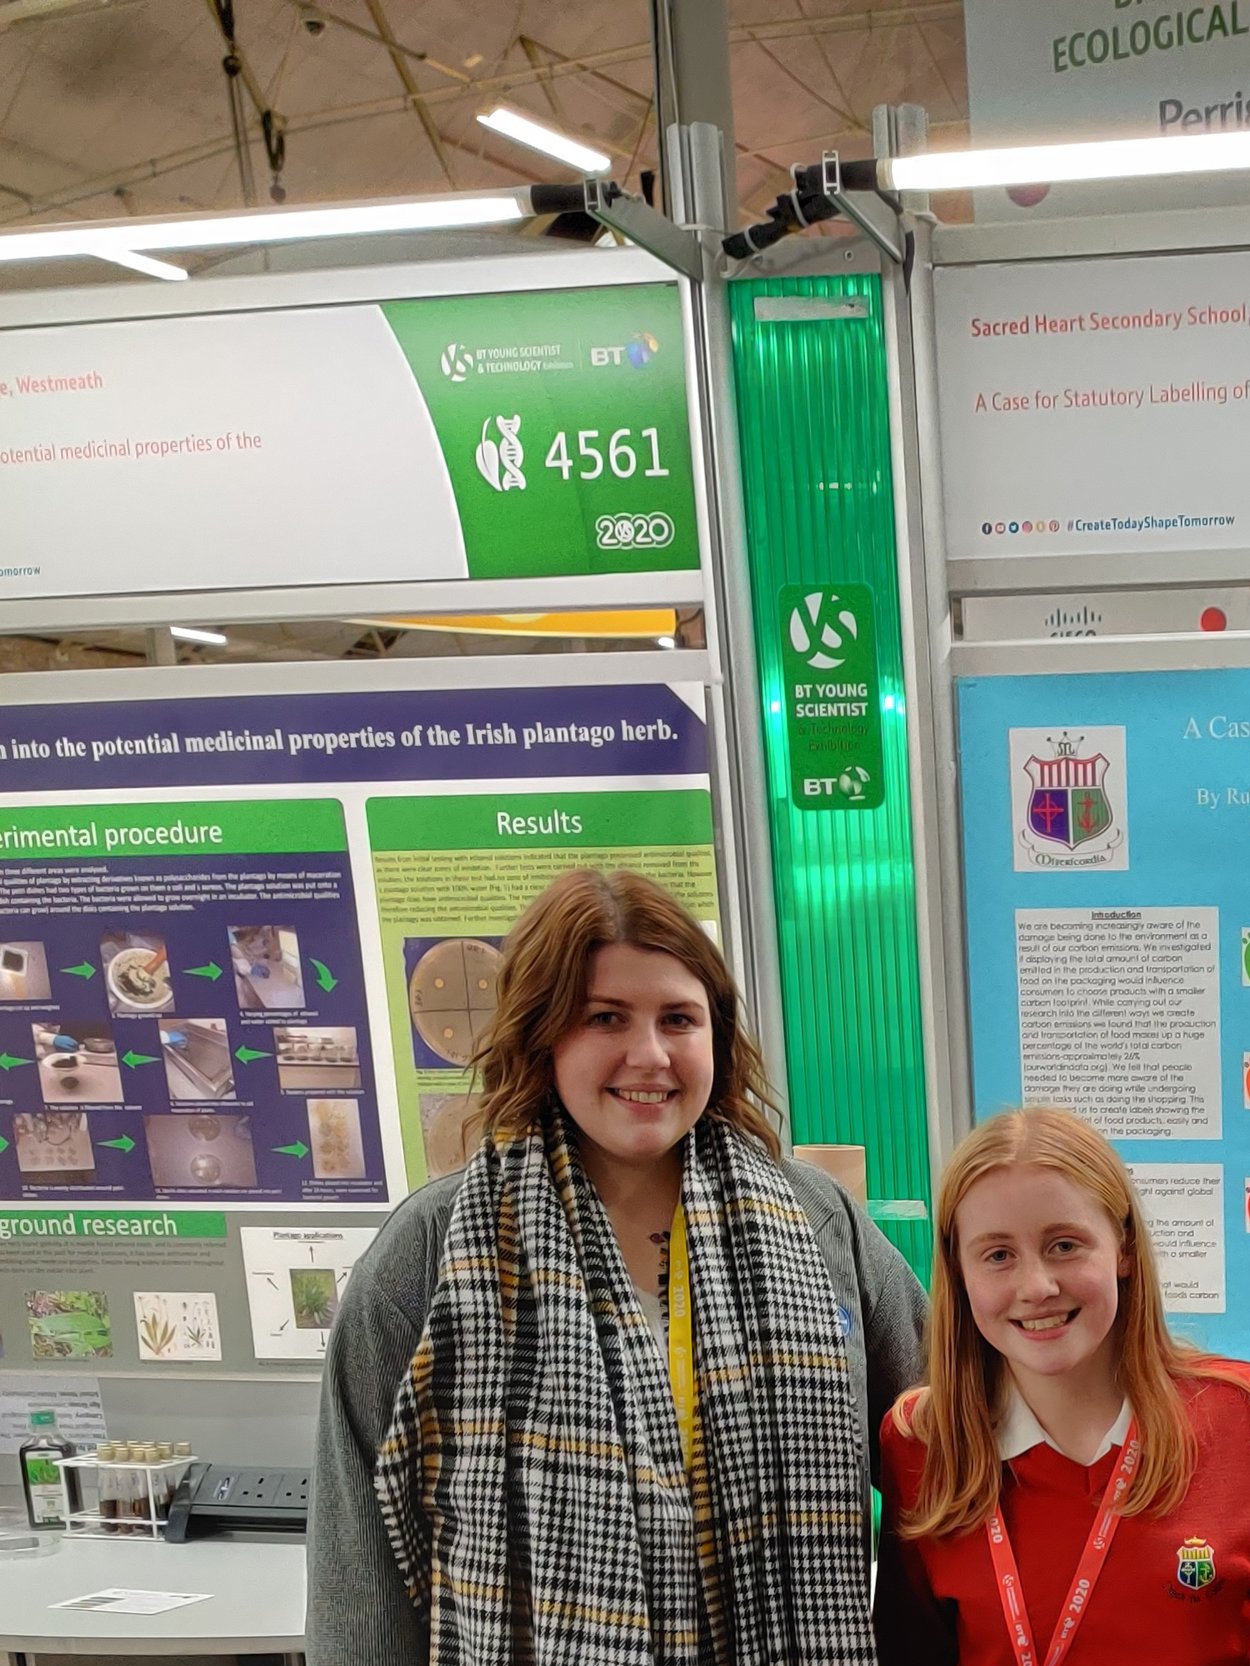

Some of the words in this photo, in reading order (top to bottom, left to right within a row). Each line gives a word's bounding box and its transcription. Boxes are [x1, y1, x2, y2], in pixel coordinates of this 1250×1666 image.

[1053, 1, 1249, 73] ECOLOGICAL
[971, 315, 1029, 337] Sacred
[1034, 313, 1085, 334] Heart
[1089, 308, 1182, 330] Secondary
[519, 344, 561, 358] SCIENTIST
[590, 345, 626, 369] BT
[485, 360, 542, 374] TECHNOLOGY
[15, 370, 103, 394] Westmeath
[975, 392, 987, 413] A
[992, 391, 1029, 411] Case
[1034, 390, 1059, 409] for
[1063, 388, 1144, 408] Statutory
[1149, 381, 1227, 404] Labelling
[1233, 379, 1250, 399] of
[60, 437, 131, 460] medicinal
[134, 433, 212, 459] properties
[216, 432, 232, 450] of
[235, 431, 262, 449] the
[545, 427, 669, 480] 4561
[1067, 514, 1235, 531] #CreateTodayShapeTomorrow
[795, 684, 813, 698] BT
[815, 683, 868, 698] YOUNG
[796, 702, 868, 717] SCIENTIST
[809, 721, 869, 736] Technology
[1182, 717, 1202, 739] A
[11, 738, 50, 759] into
[55, 736, 86, 757] the
[91, 733, 180, 761] potential
[184, 728, 284, 753] medicinal
[287, 726, 395, 755] properties
[400, 725, 423, 747] of
[426, 724, 460, 746] the
[465, 722, 517, 745] Irish
[522, 721, 615, 749] plantago
[621, 718, 679, 741] herb.
[808, 738, 860, 752] Exhibition
[803, 778, 837, 795] BT
[1197, 788, 1220, 809] By
[497, 809, 582, 835] Results
[104, 819, 222, 851] procedure
[1091, 911, 1142, 920] Introduction
[83, 1214, 178, 1236] research
[302, 1231, 344, 1240] applications
[1069, 1578, 1090, 1614] 2020
